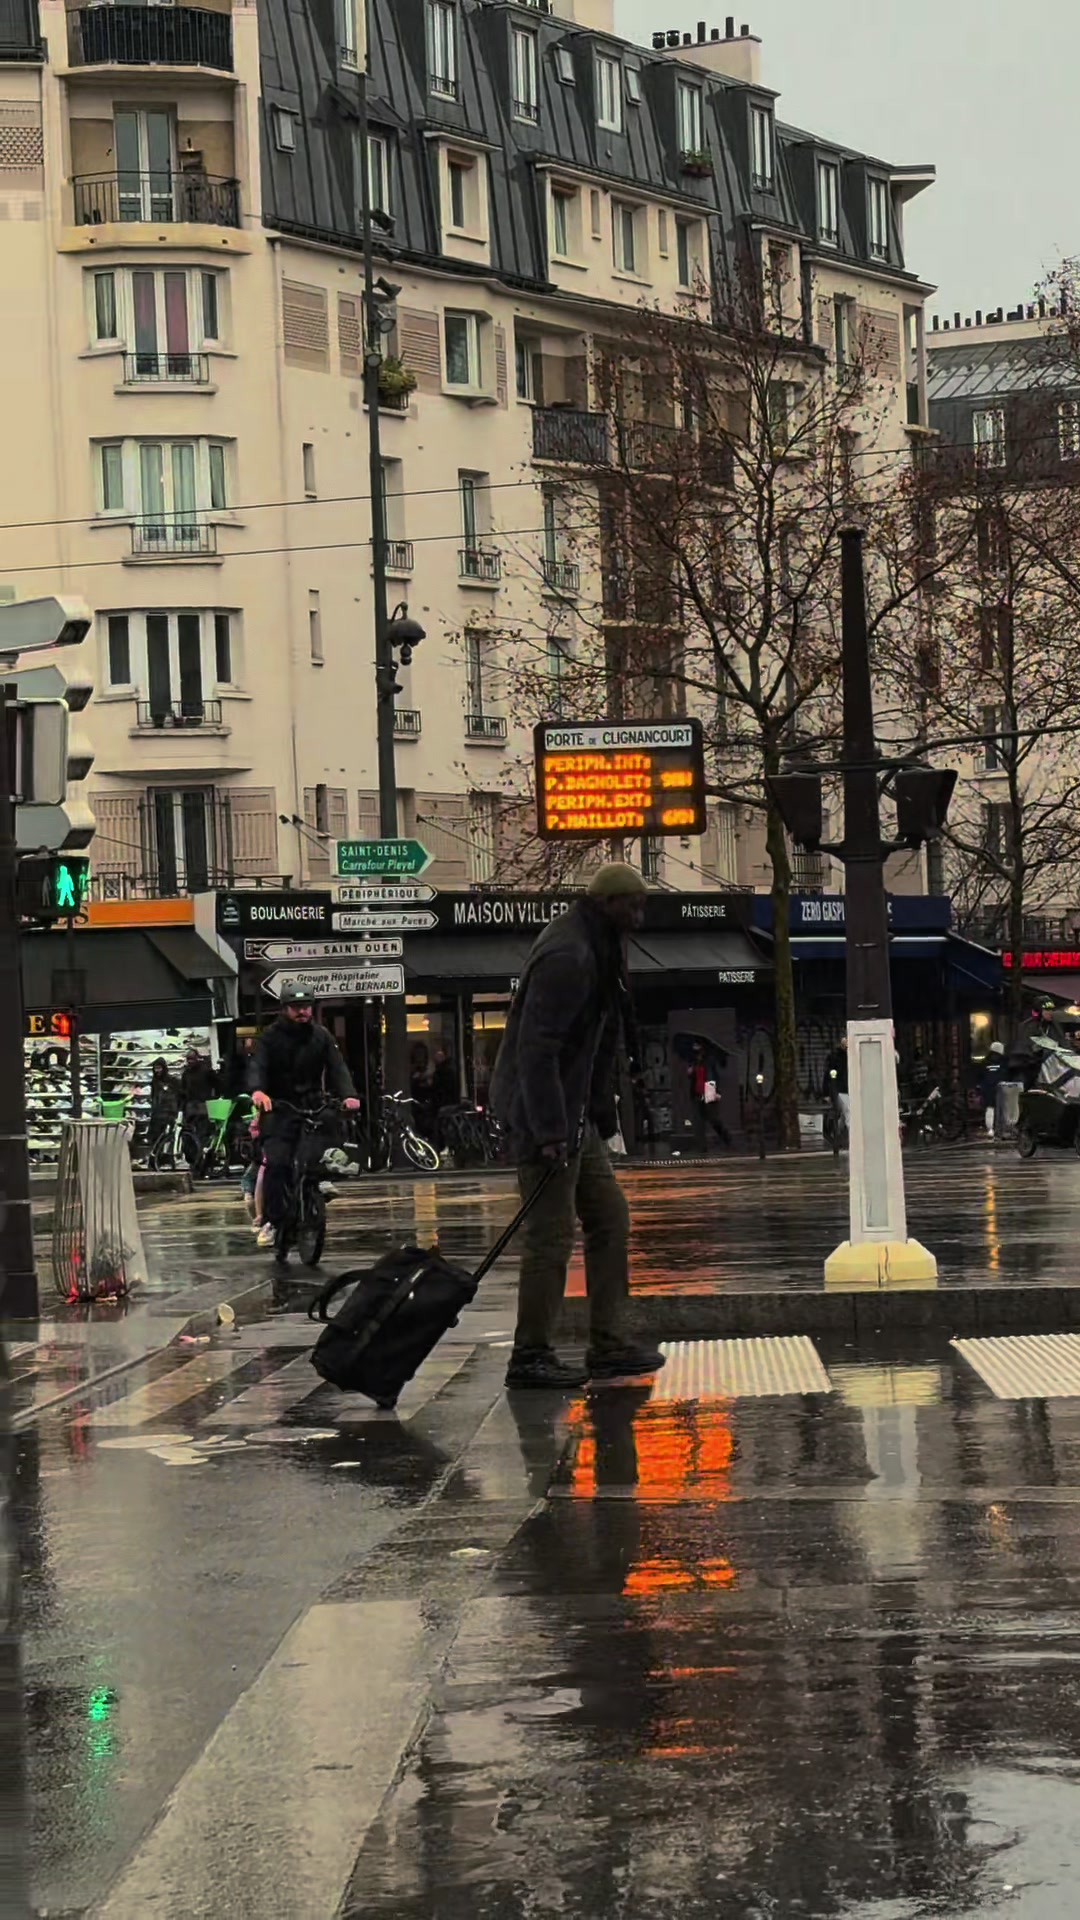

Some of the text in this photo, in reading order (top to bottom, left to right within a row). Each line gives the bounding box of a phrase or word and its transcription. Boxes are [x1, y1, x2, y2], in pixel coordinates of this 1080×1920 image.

[546, 732, 584, 746] PORTE
[602, 729, 691, 745] CLIGNANCOURT
[341, 845, 409, 857] SAINT-DENIS
[342, 859, 416, 872] Carrefour Pleyel
[341, 888, 420, 900] PÉRIPHÉRIQUE
[250, 906, 325, 921] BOULANGERIE
[454, 901, 514, 924] MAISON
[681, 903, 727, 918] PÂTISSERIE
[800, 901, 822, 921] ZERO
[342, 916, 377, 926] Marché
[401, 915, 429, 926] Puces
[323, 944, 359, 955] SAINT
[365, 943, 398, 953] OUEN
[297, 973, 329, 983] Groupe
[355, 980, 400, 991] BERNARD
